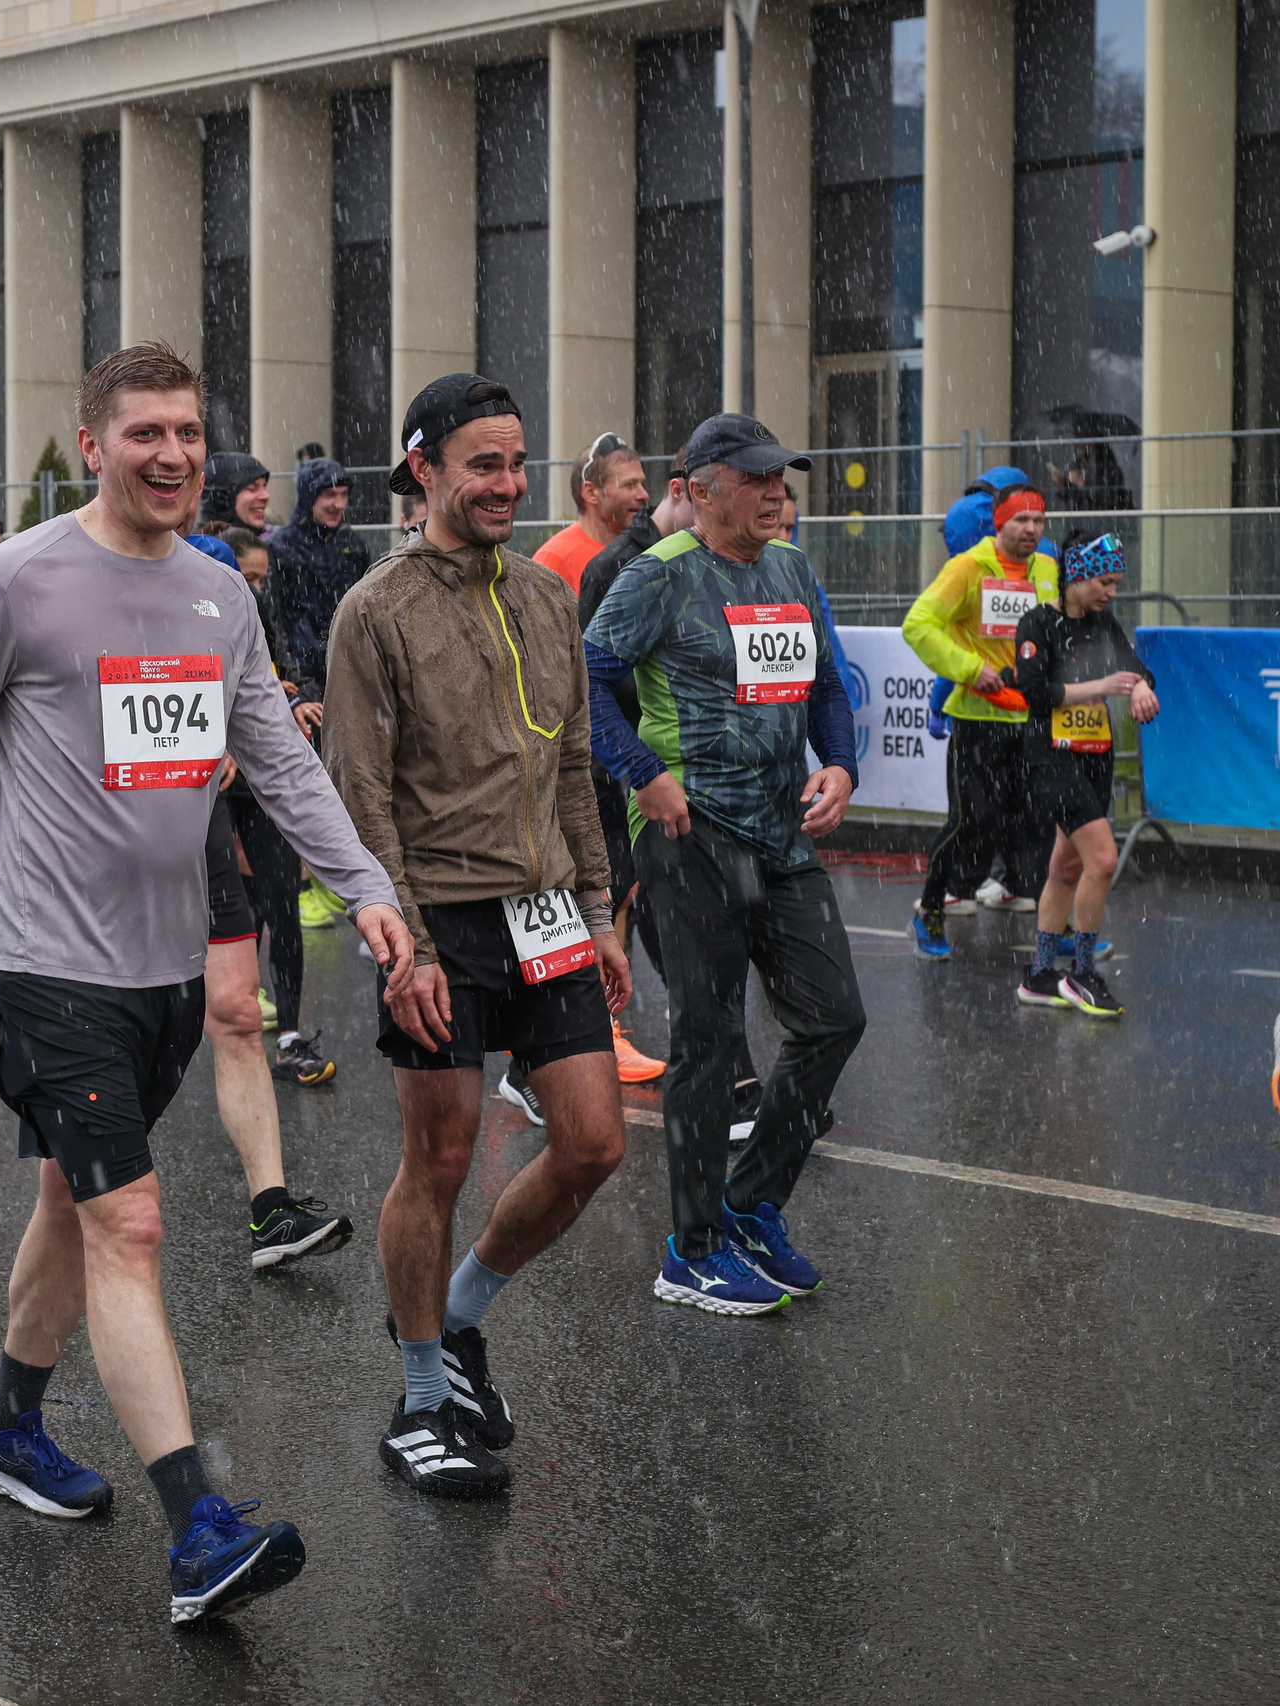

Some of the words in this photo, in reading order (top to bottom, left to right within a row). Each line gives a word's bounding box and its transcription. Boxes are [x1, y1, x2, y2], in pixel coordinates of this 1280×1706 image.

[991, 595, 1031, 613] 8666
[748, 631, 807, 662] 6026
[139, 658, 180, 666] МОСКОВСКИЙ
[761, 662, 795, 673] АЛЕКСЕЙ
[746, 685, 758, 701] E
[122, 693, 209, 735] 1094
[1061, 709, 1103, 729] 3864
[153, 737, 180, 748] ПЕТР
[883, 734, 925, 758] БЕГА
[118, 765, 133, 787] E
[517, 888, 579, 933] 281
[532, 959, 547, 980] D
